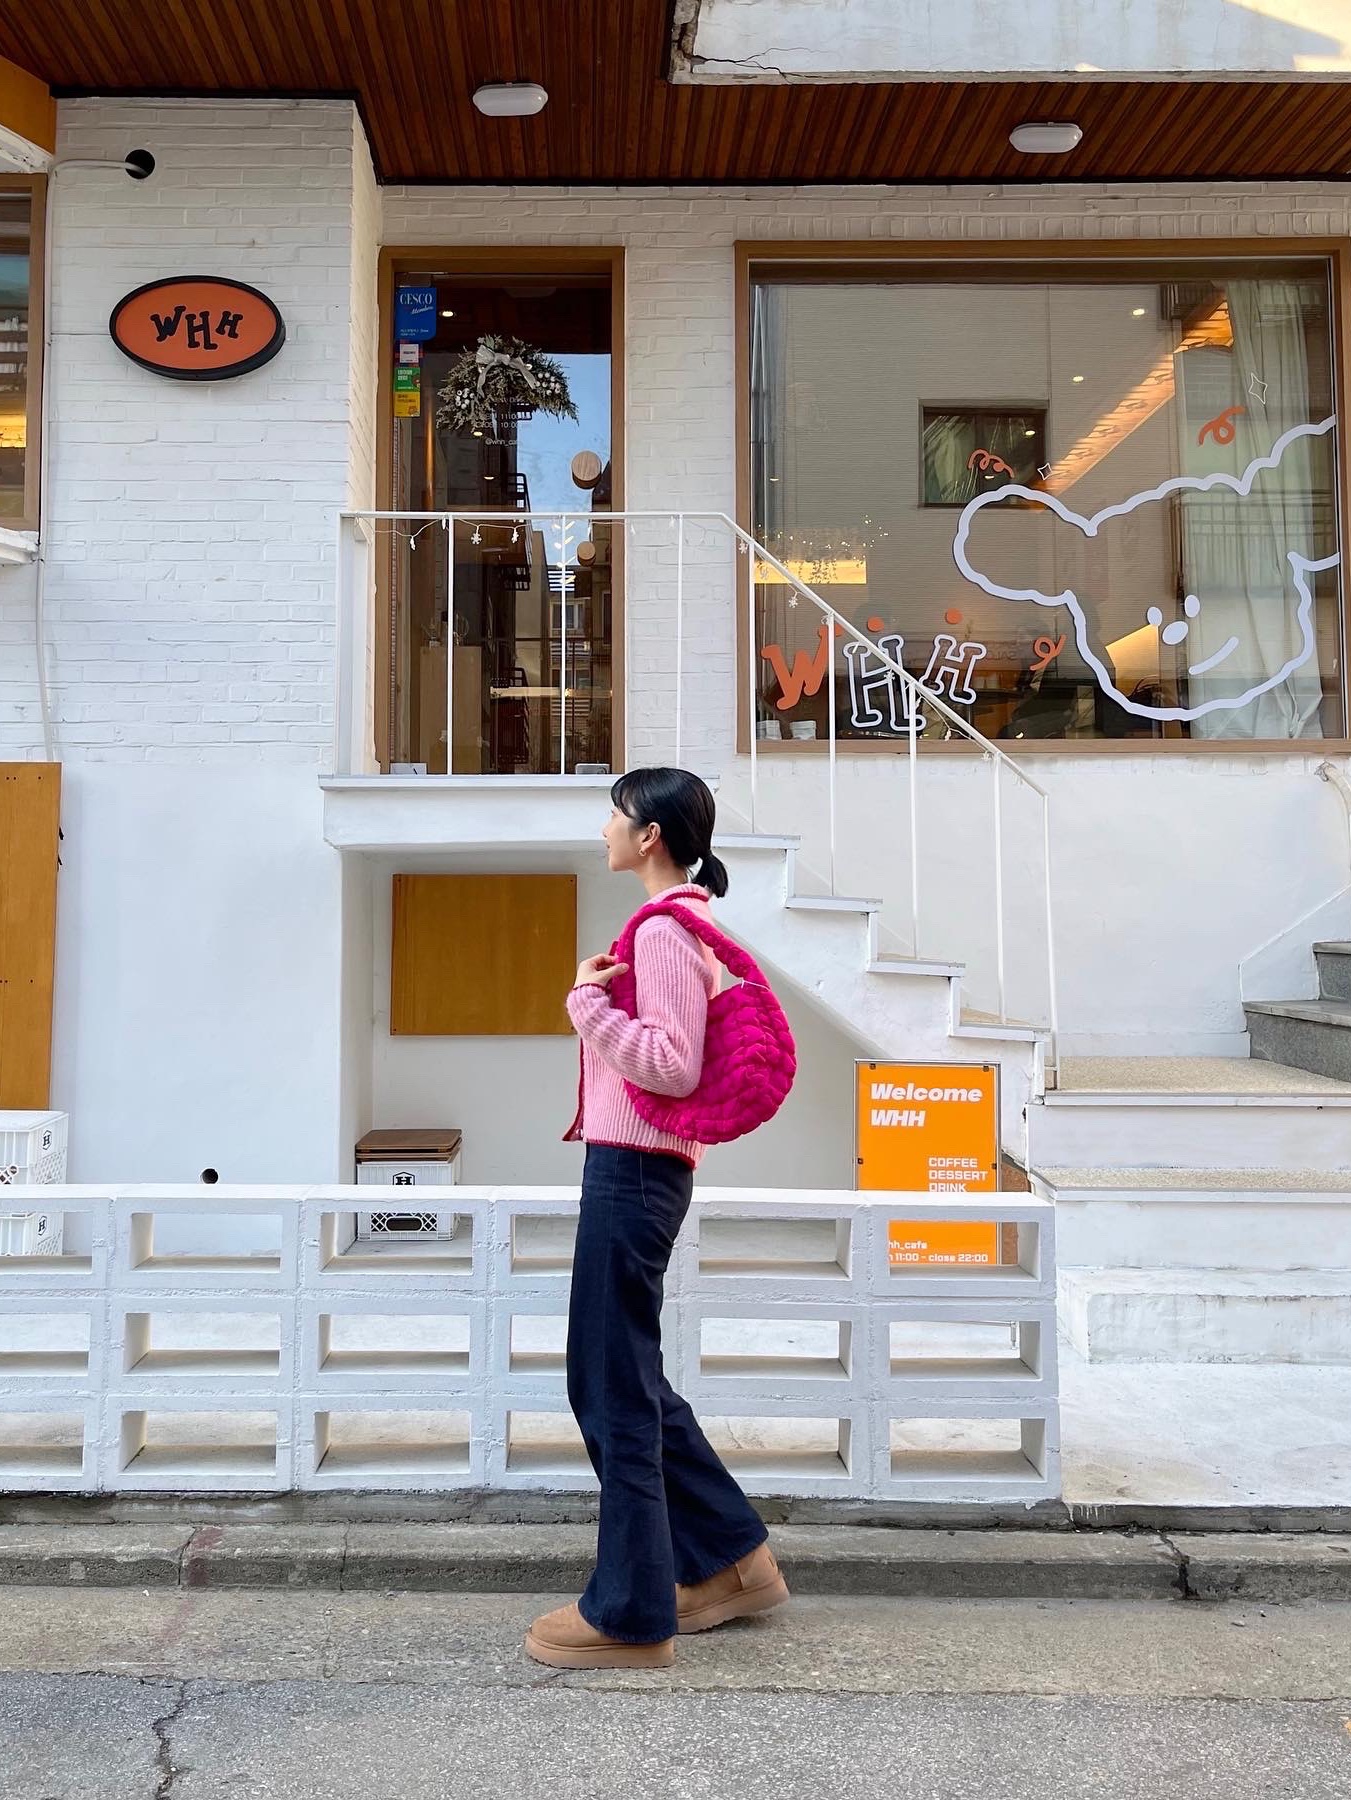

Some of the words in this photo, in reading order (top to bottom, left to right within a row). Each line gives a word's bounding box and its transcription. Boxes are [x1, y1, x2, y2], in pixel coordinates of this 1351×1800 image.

[399, 293, 433, 305] CESCO
[150, 305, 244, 350] WHH
[761, 623, 987, 731] WHH
[870, 1083, 983, 1103] Welcome
[870, 1109, 926, 1127] WHH
[929, 1157, 978, 1168] COFFEE
[929, 1170, 988, 1181] DESSERT
[929, 1182, 967, 1192] DRINK
[888, 1240, 928, 1250] hh_cafe
[895, 1252, 920, 1262] 11:00
[928, 1253, 956, 1262] close
[957, 1253, 988, 1263] 22:00
